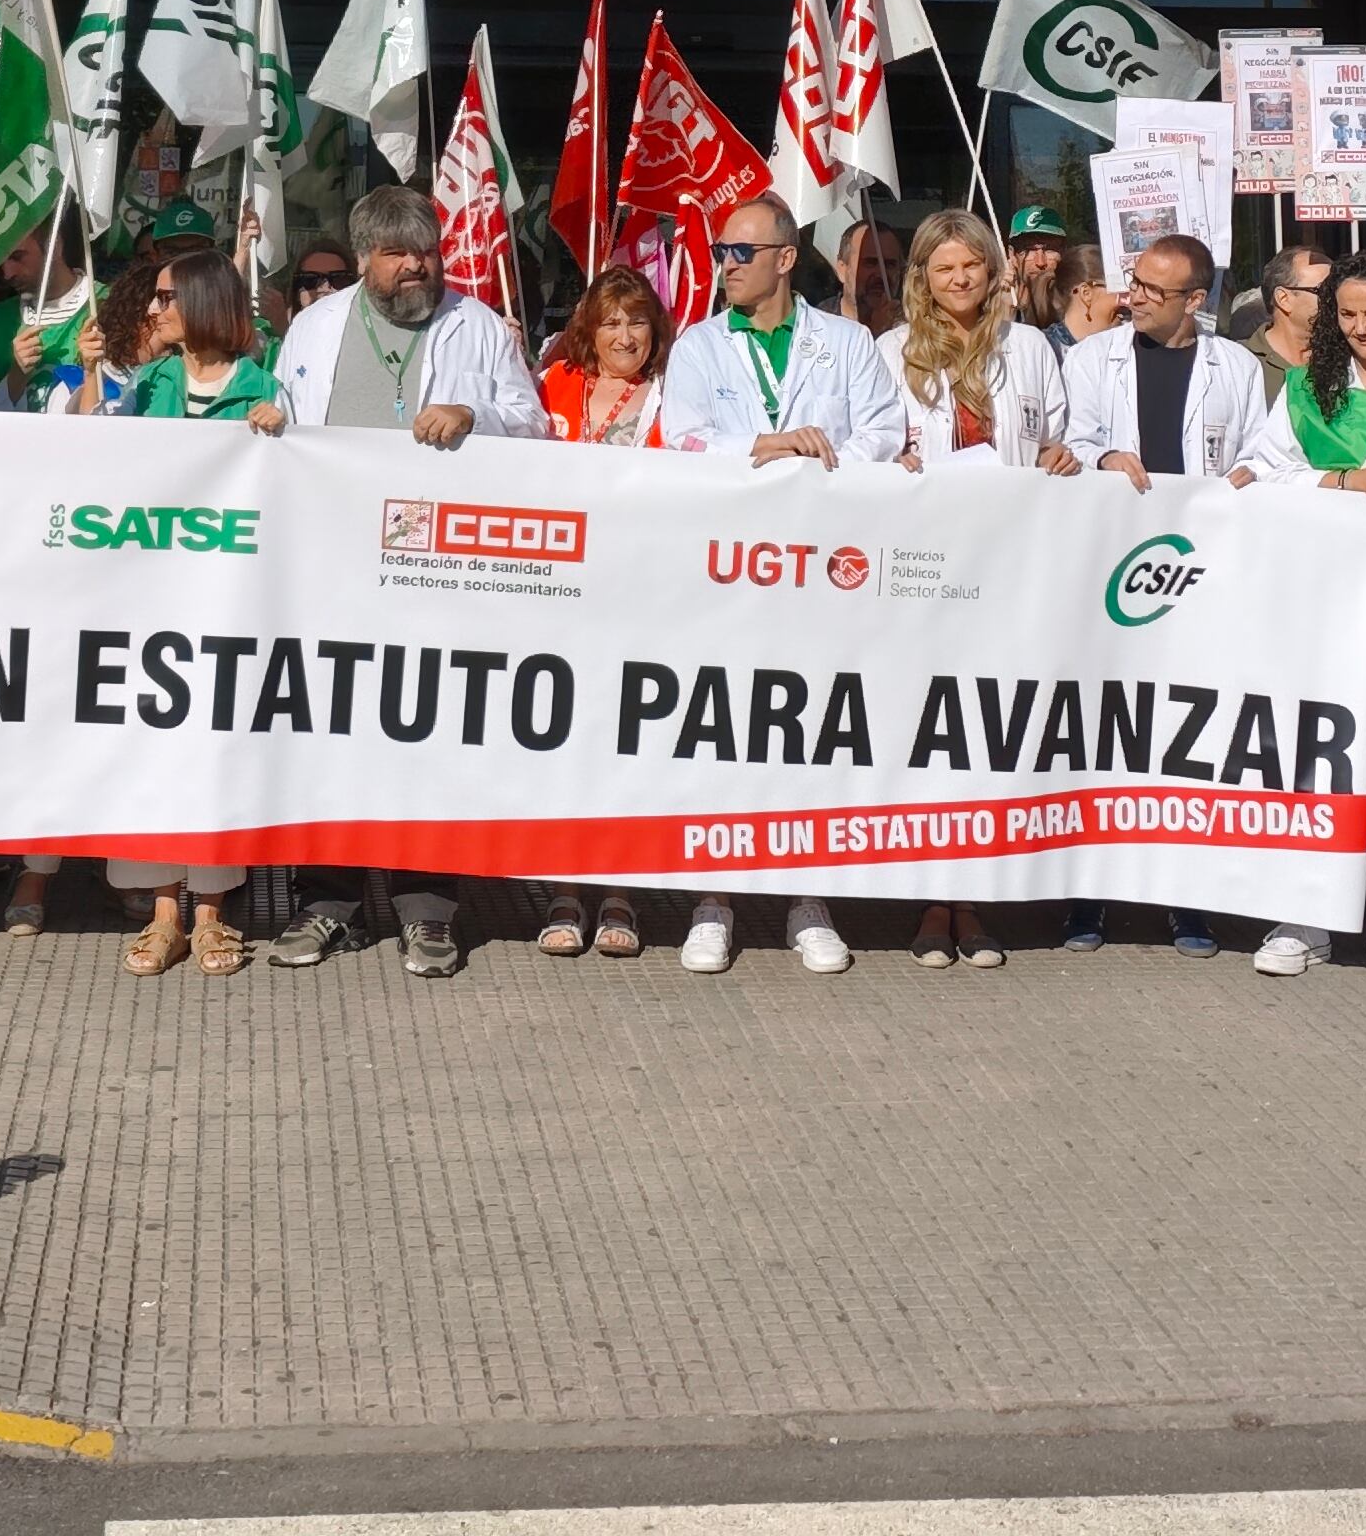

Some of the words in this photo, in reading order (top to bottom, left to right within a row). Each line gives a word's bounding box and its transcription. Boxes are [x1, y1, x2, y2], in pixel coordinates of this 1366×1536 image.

[1054, 21, 1159, 90] CSIF
[1337, 64, 1365, 83] ¡NO!
[1148, 132, 1157, 142] EL
[43, 503, 65, 548] fses
[68, 504, 261, 554] SATSE
[445, 513, 577, 552] CCOO
[380, 552, 463, 570] federación
[468, 557, 486, 571] de
[491, 562, 553, 577] sanidad
[707, 539, 818, 588] UGT
[892, 548, 946, 562] Servicios
[379, 573, 389, 587] y
[392, 573, 459, 590] sectores
[464, 578, 583, 598] sociosanitarios
[891, 565, 942, 580] Públicos
[1125, 562, 1207, 596] CSIF
[890, 583, 936, 598] Sector
[940, 584, 980, 600] Salud
[75, 629, 576, 752] ESTATUTO
[616, 660, 875, 768] PARA
[907, 675, 1358, 795] AVANZAR
[683, 822, 756, 860] POR
[767, 819, 815, 858] UN
[828, 810, 995, 854] ESTATUTO
[1006, 800, 1083, 842] PARA
[1095, 794, 1336, 840] TODOS/TODAS
